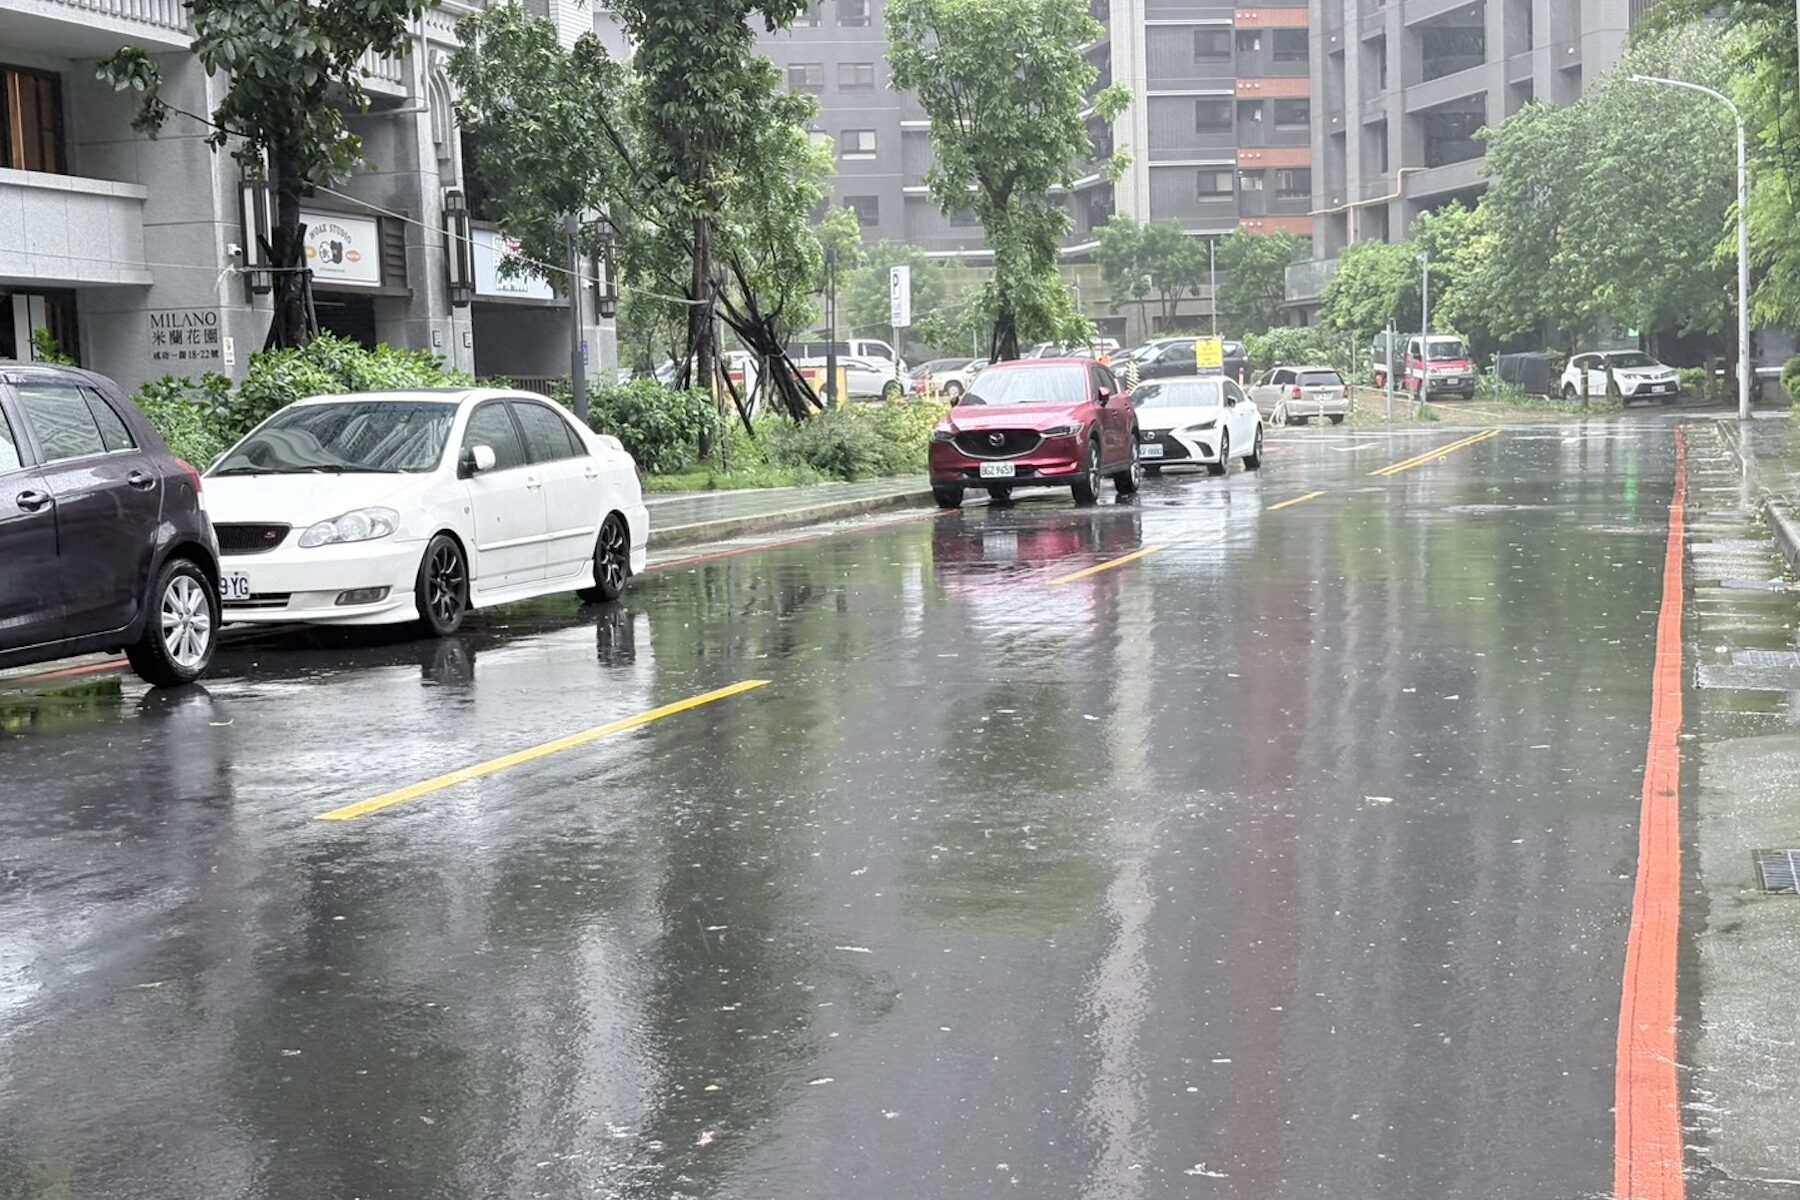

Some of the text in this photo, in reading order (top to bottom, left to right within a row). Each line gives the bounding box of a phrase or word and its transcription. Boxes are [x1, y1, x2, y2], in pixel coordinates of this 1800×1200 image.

[329, 223, 352, 244] STUDIO
[150, 311, 217, 329] MILANO
[151, 328, 218, 346] 米蘭花園
